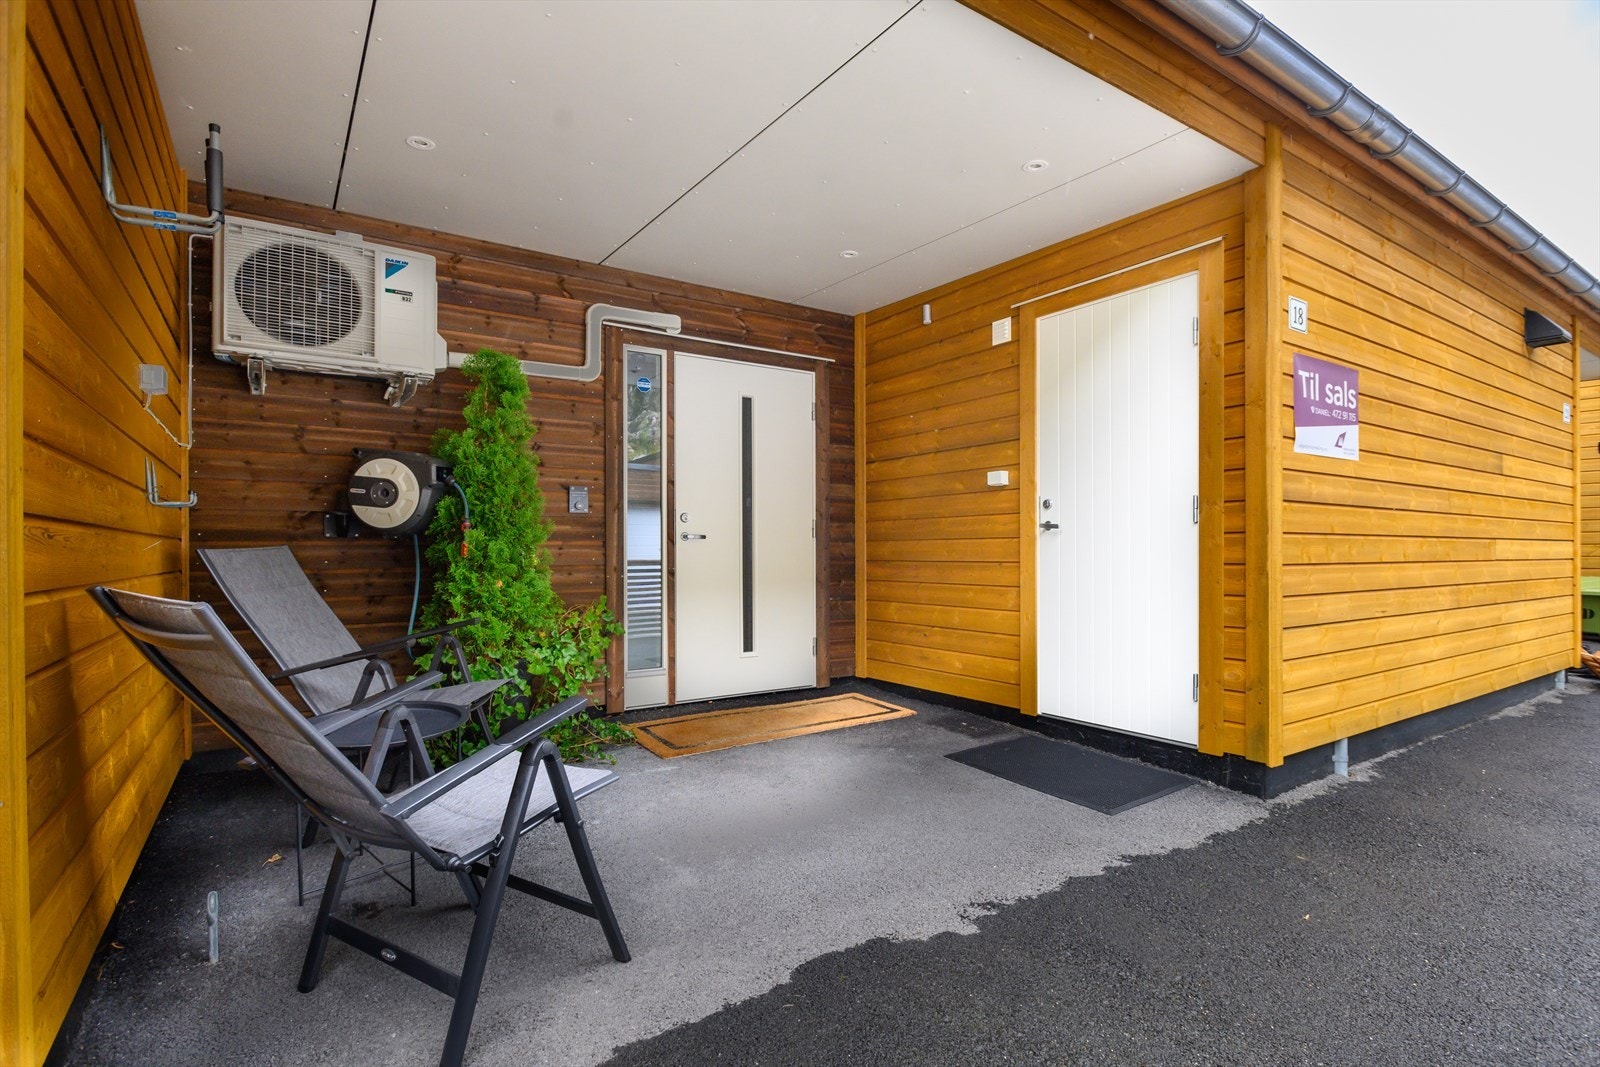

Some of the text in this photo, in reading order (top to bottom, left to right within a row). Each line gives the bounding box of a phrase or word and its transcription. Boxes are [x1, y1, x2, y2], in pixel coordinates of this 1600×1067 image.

[1293, 306, 1304, 326] 18
[1298, 369, 1357, 409] Til sals
[1332, 409, 1342, 420] 472
[1342, 411, 1348, 420] 91
[1348, 412, 1357, 421] 115
